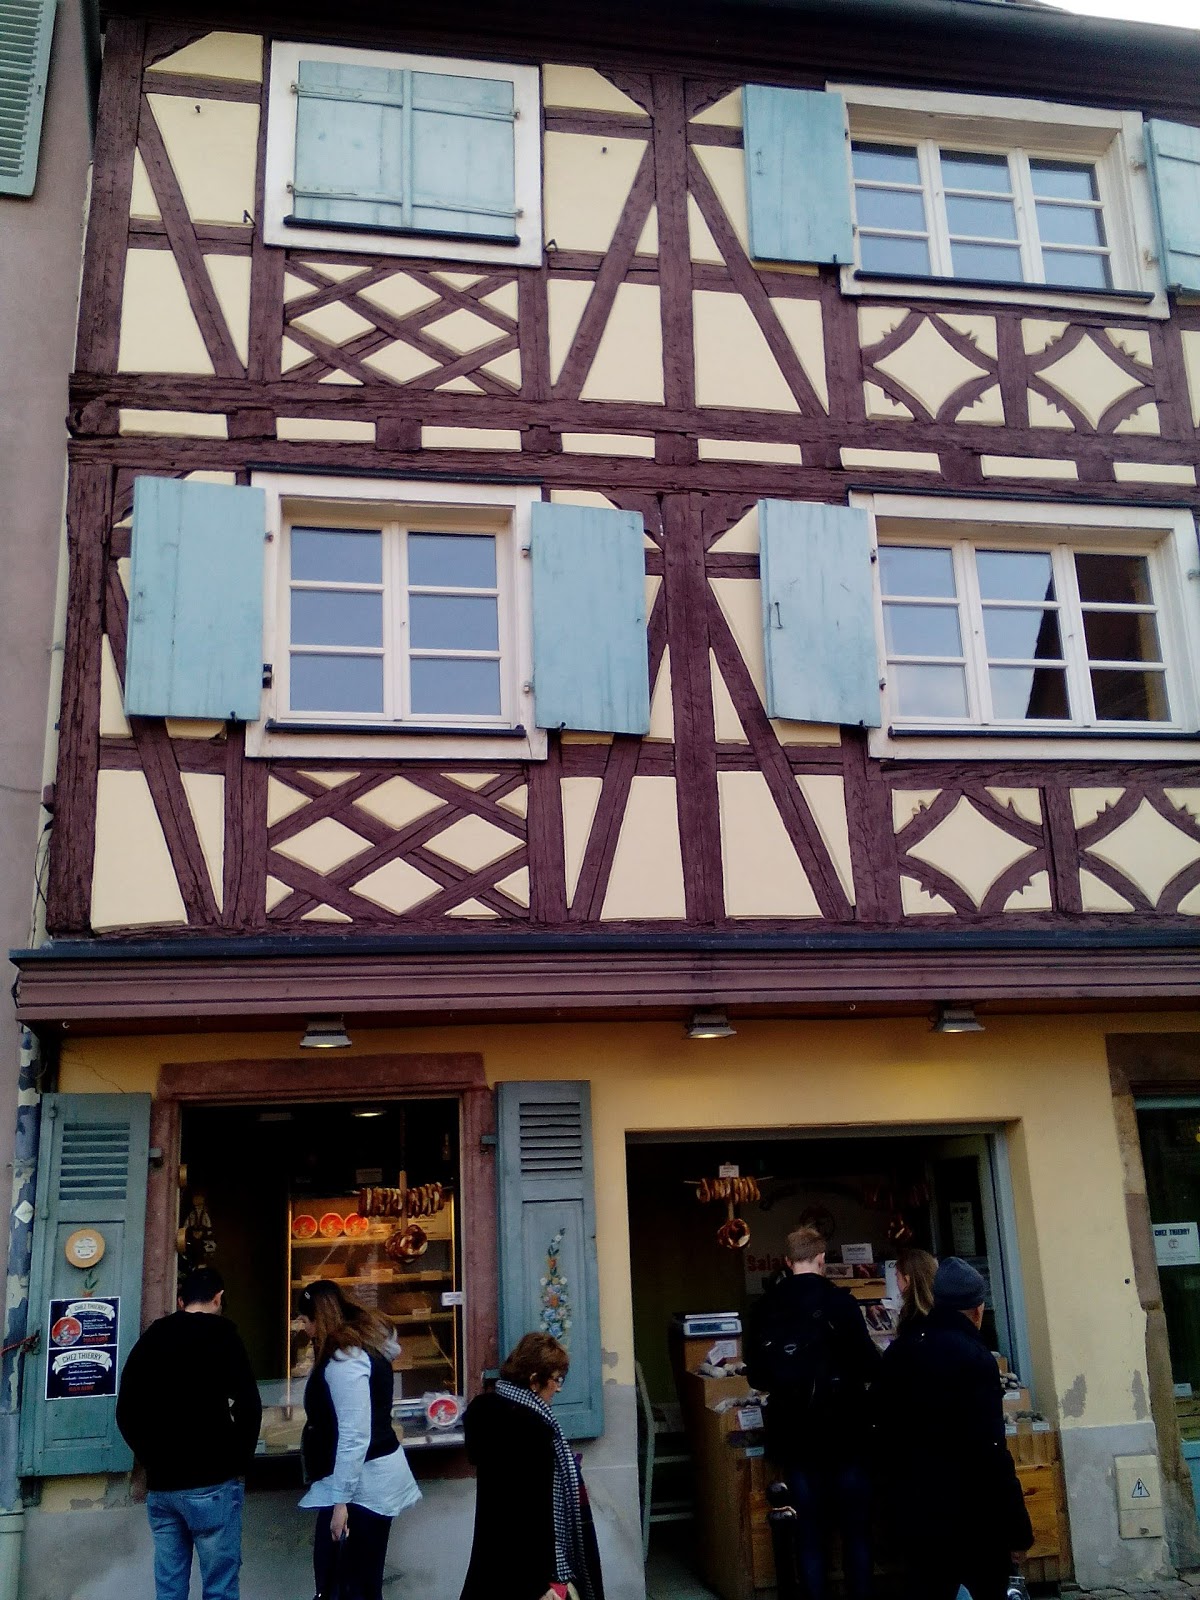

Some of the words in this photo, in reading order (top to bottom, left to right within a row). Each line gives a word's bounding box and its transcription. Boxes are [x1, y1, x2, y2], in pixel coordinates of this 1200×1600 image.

[1169, 1228, 1190, 1236] THIERRY
[75, 1303, 87, 1311] CHEZ
[88, 1302, 108, 1311] THIERRY
[62, 1353, 77, 1362] CHEZ
[78, 1352, 102, 1360] THIERRY
